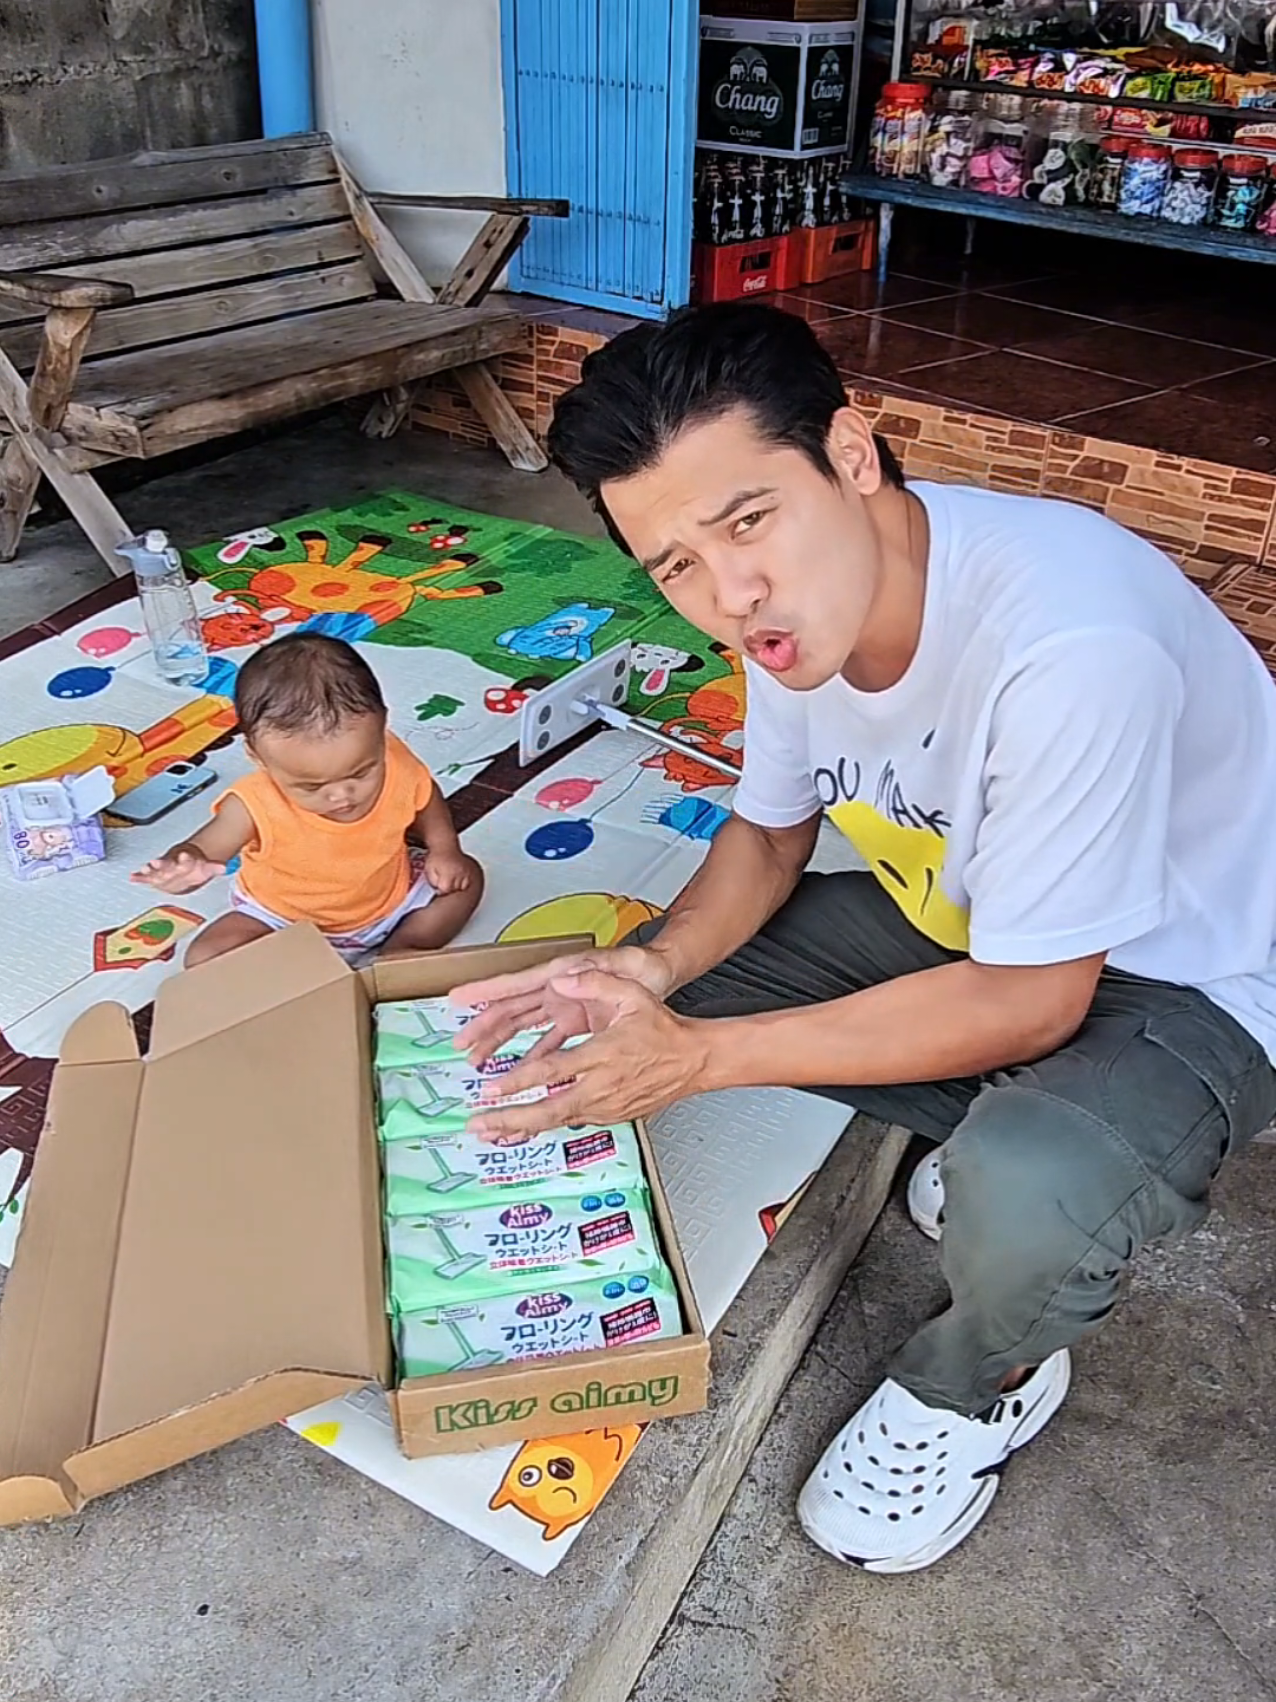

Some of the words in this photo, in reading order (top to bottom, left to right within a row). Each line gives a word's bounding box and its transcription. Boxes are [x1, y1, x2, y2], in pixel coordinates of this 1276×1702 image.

[715, 83, 781, 119] Chang
[811, 80, 845, 101] Chang
[475, 1140, 557, 1166] フローリング
[484, 1222, 573, 1246] フローリング
[523, 1302, 569, 1319] Aimy
[501, 1311, 594, 1341] フローリング
[512, 1331, 589, 1354] ウエットシート
[436, 1396, 539, 1433] Kiss
[550, 1375, 679, 1413] aimy
